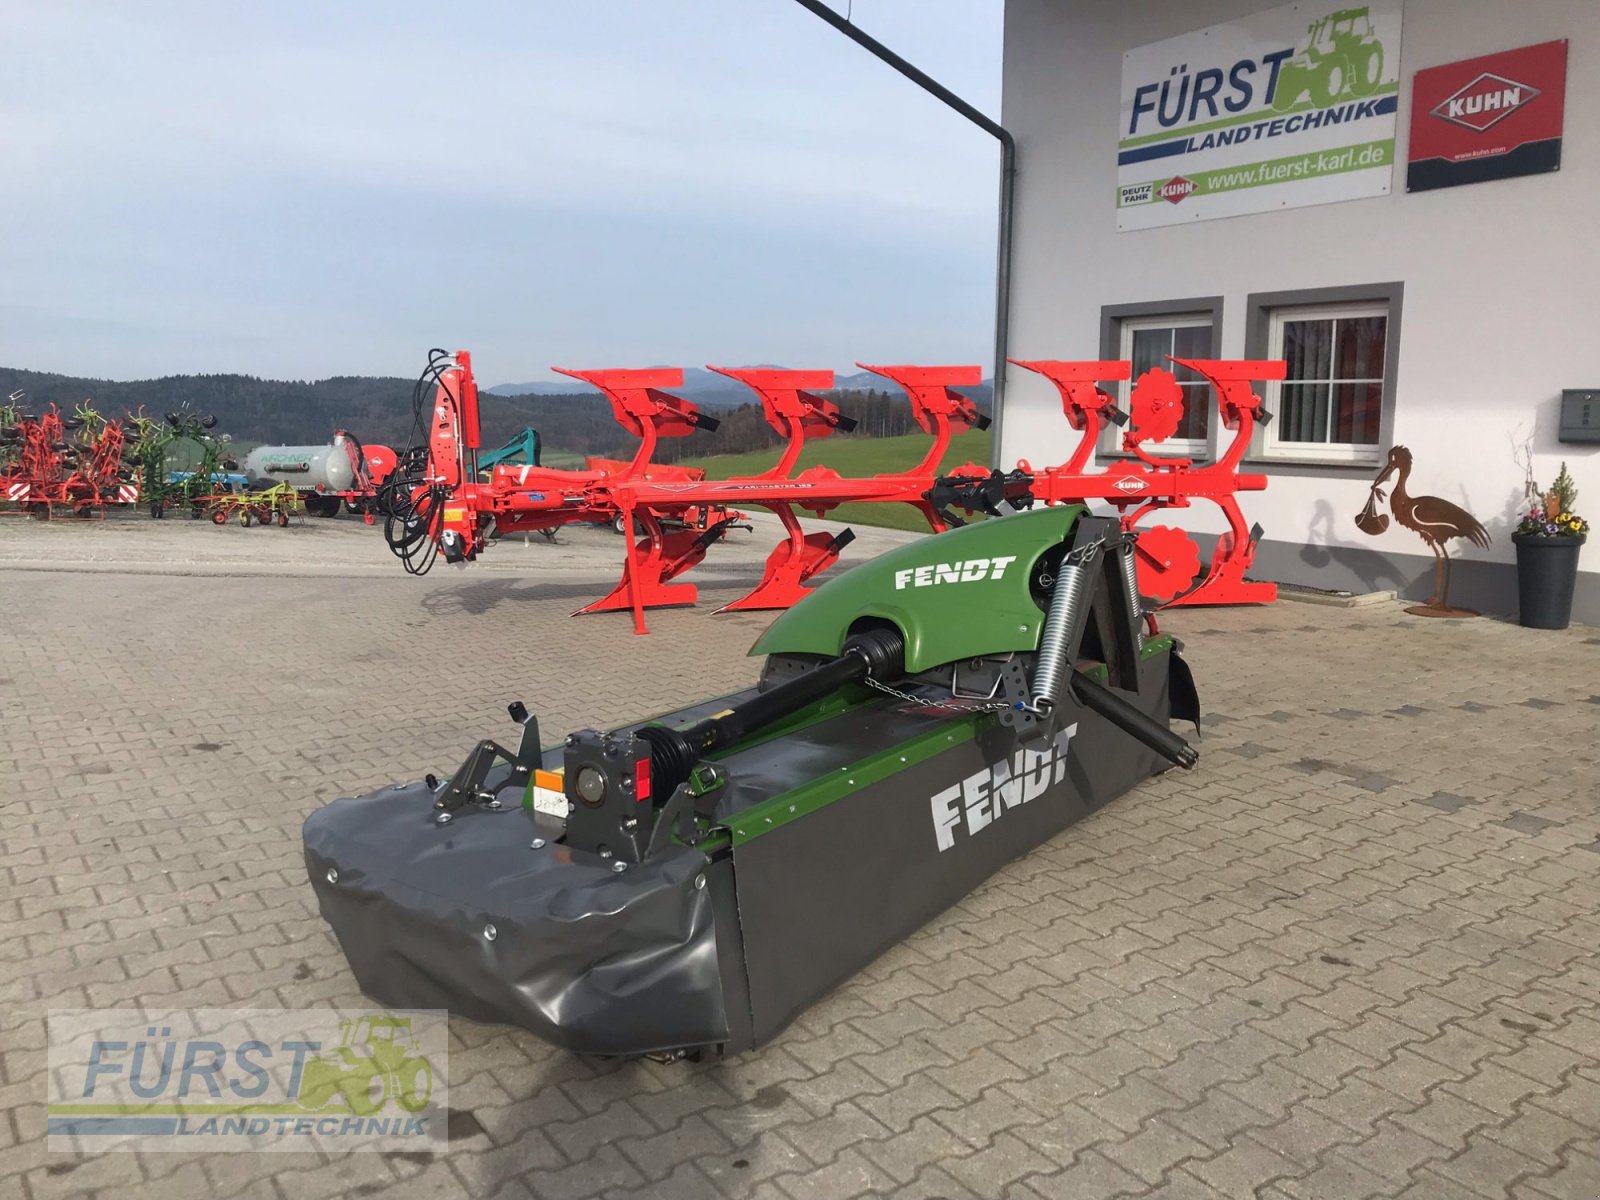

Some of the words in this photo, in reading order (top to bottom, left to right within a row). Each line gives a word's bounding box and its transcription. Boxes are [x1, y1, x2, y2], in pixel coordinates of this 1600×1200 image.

[1129, 48, 1295, 134] FÜRST
[1449, 87, 1520, 117] KUHN
[1186, 100, 1378, 153] LANDTECHNIK
[1208, 144, 1385, 190] www.fuerst-karl.de
[1455, 146, 1506, 159] www.kuhn.com
[1122, 185, 1152, 196] DEUTZ
[1125, 193, 1148, 203] FAHR
[1161, 182, 1193, 197] KUHN
[895, 556, 1016, 590] FENDT
[931, 722, 1078, 852] FENDT
